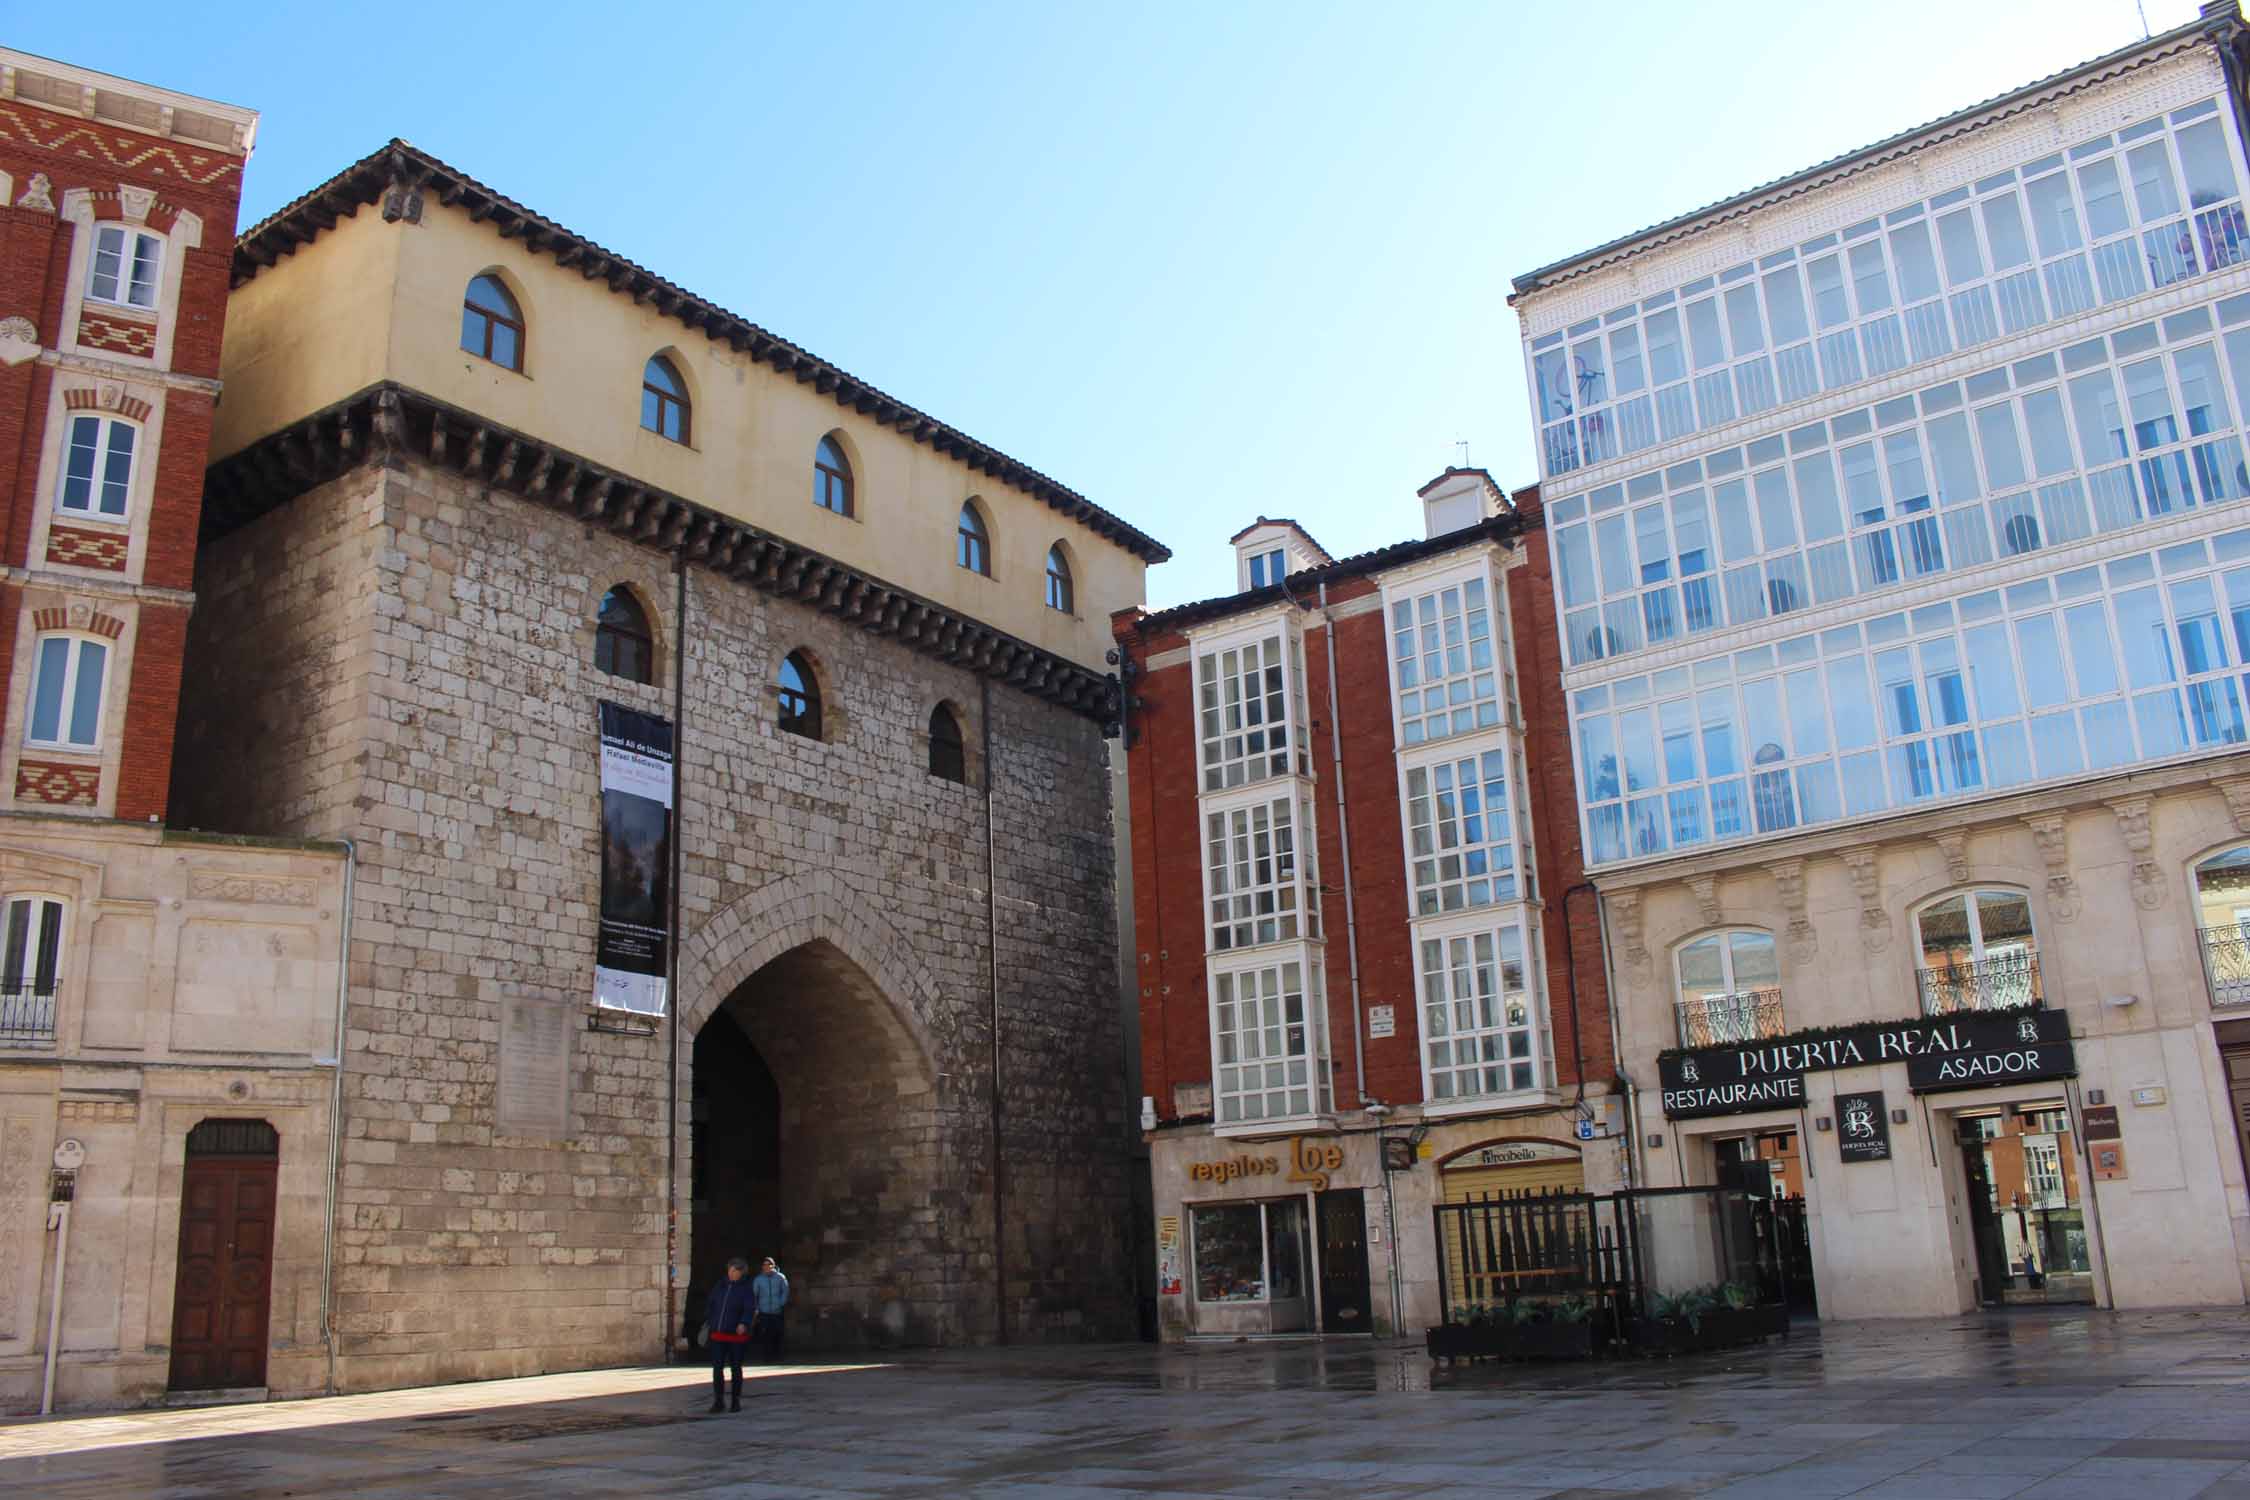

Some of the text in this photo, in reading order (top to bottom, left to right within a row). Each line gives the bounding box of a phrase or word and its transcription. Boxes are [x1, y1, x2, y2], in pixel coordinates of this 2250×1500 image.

[1738, 1024, 1972, 1076] PUERTA REAL
[1938, 1050, 2041, 1080] ASADOR
[1663, 1077, 1801, 1110] RESTAURANTE
[1188, 1154, 1280, 1184] regalos
